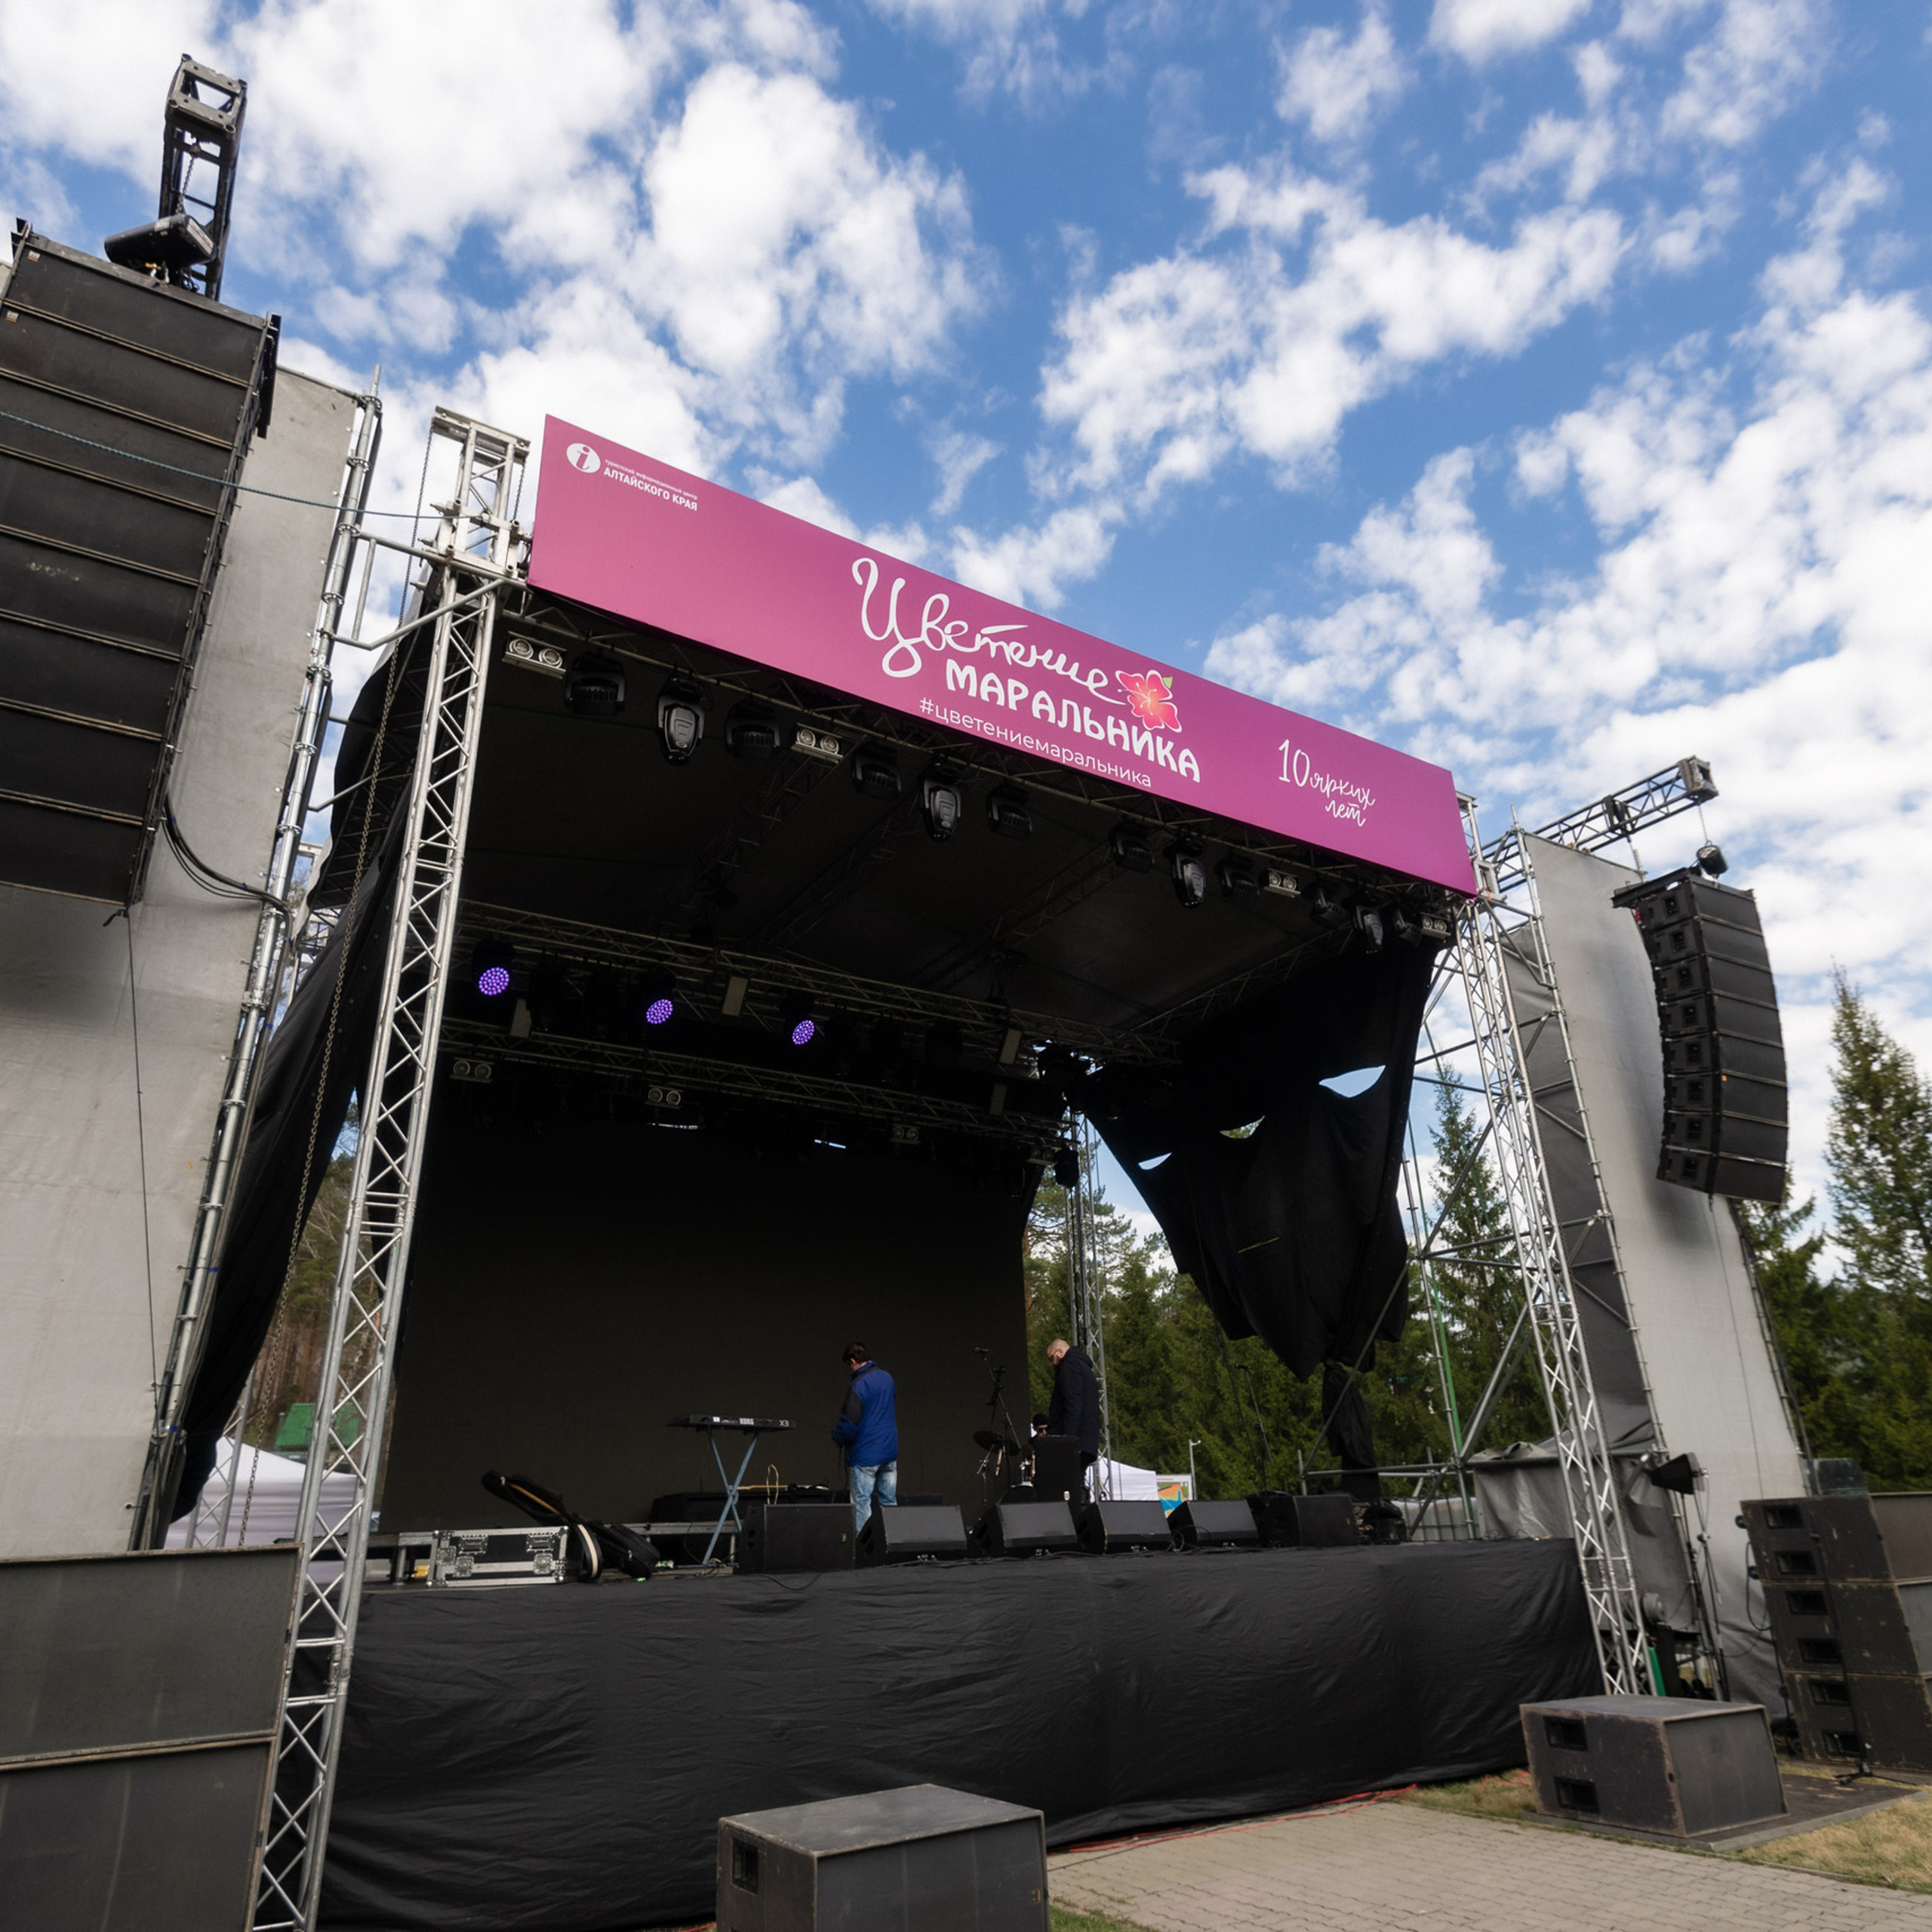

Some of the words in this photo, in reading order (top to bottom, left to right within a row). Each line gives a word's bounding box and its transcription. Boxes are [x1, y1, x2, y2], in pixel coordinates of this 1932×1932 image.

[604, 467, 670, 500] АЛТАЙСКОГО
[672, 494, 698, 512] КРАЯ
[852, 558, 1126, 678] Цветение
[919, 697, 1152, 788] #цветениемаральника
[946, 658, 1201, 783] МАРАЛЬНИКА
[1278, 739, 1310, 787] 10
[1310, 772, 1375, 811] ярких
[1325, 800, 1366, 827] лет
